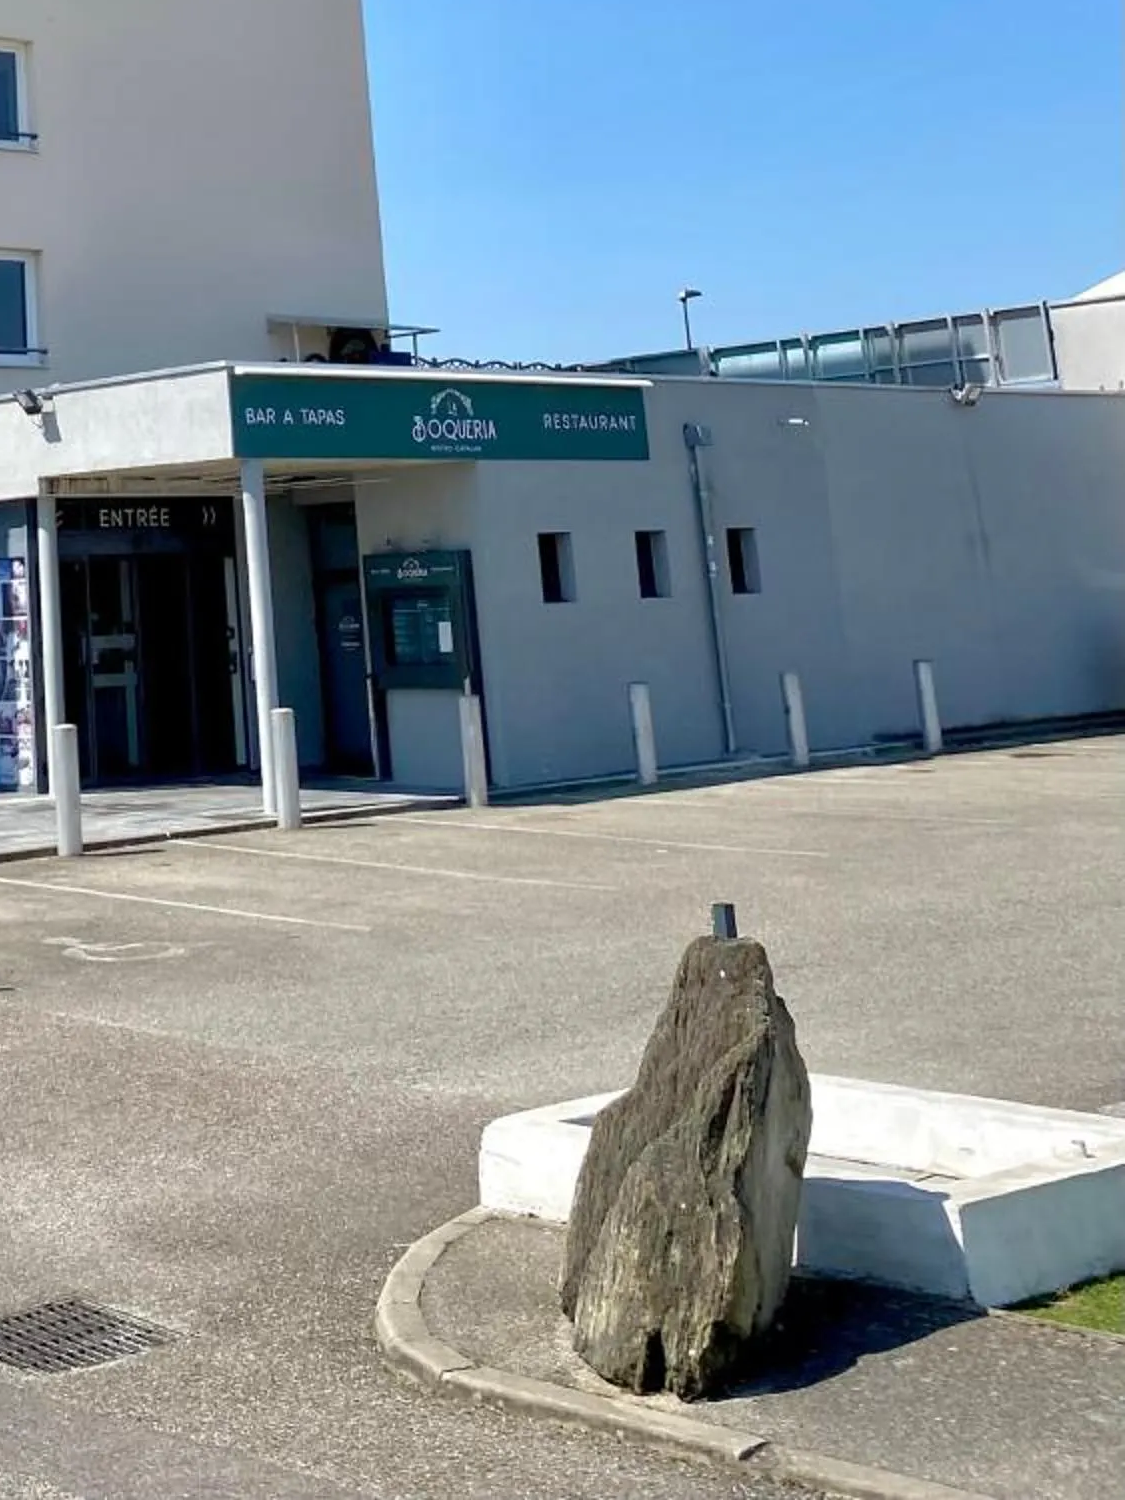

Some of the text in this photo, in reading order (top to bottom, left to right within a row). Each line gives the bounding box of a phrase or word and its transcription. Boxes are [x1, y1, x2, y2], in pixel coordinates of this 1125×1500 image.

[245, 407, 276, 424] BAR
[300, 408, 346, 426] TAPAS
[543, 412, 636, 431] RESTAURANT
[412, 415, 498, 442] BOQUERIA
[99, 505, 171, 528] ENTRÉE
